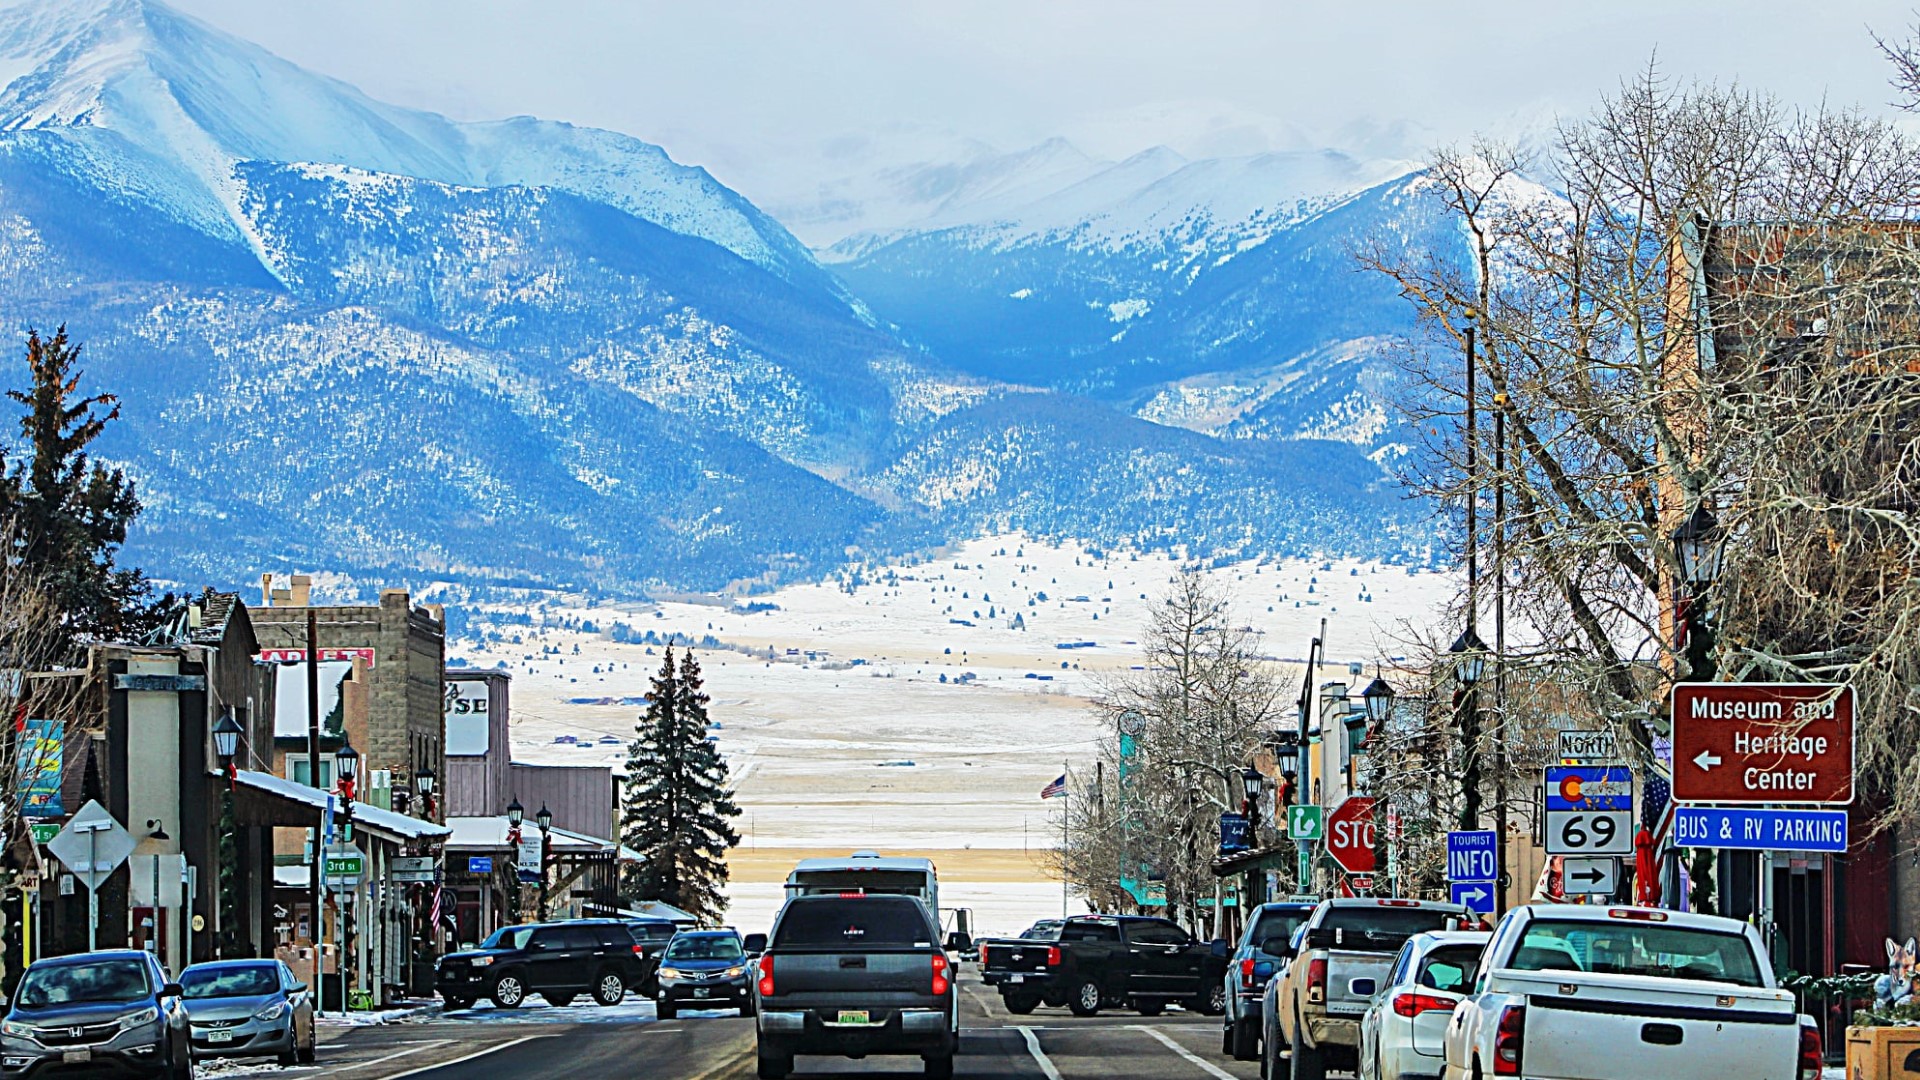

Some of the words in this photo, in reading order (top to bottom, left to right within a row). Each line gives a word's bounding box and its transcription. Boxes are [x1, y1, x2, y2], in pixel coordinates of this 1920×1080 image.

[1691, 697, 1782, 719] Museum
[1793, 699, 1835, 720] and
[1562, 735, 1616, 754] NORTH
[1735, 731, 1828, 761] Heritage
[1743, 767, 1817, 790] Center
[1334, 820, 1377, 849] STO
[1562, 815, 1616, 848] 69
[1679, 816, 1708, 838] BUS
[1719, 816, 1732, 839] &
[1744, 818, 1763, 840] RV
[1774, 818, 1842, 842] PARKING
[1453, 836, 1490, 846] TOURIST
[328, 861, 345, 871] 3rd
[1450, 850, 1494, 877] INFO
[20, 877, 37, 887] ART
